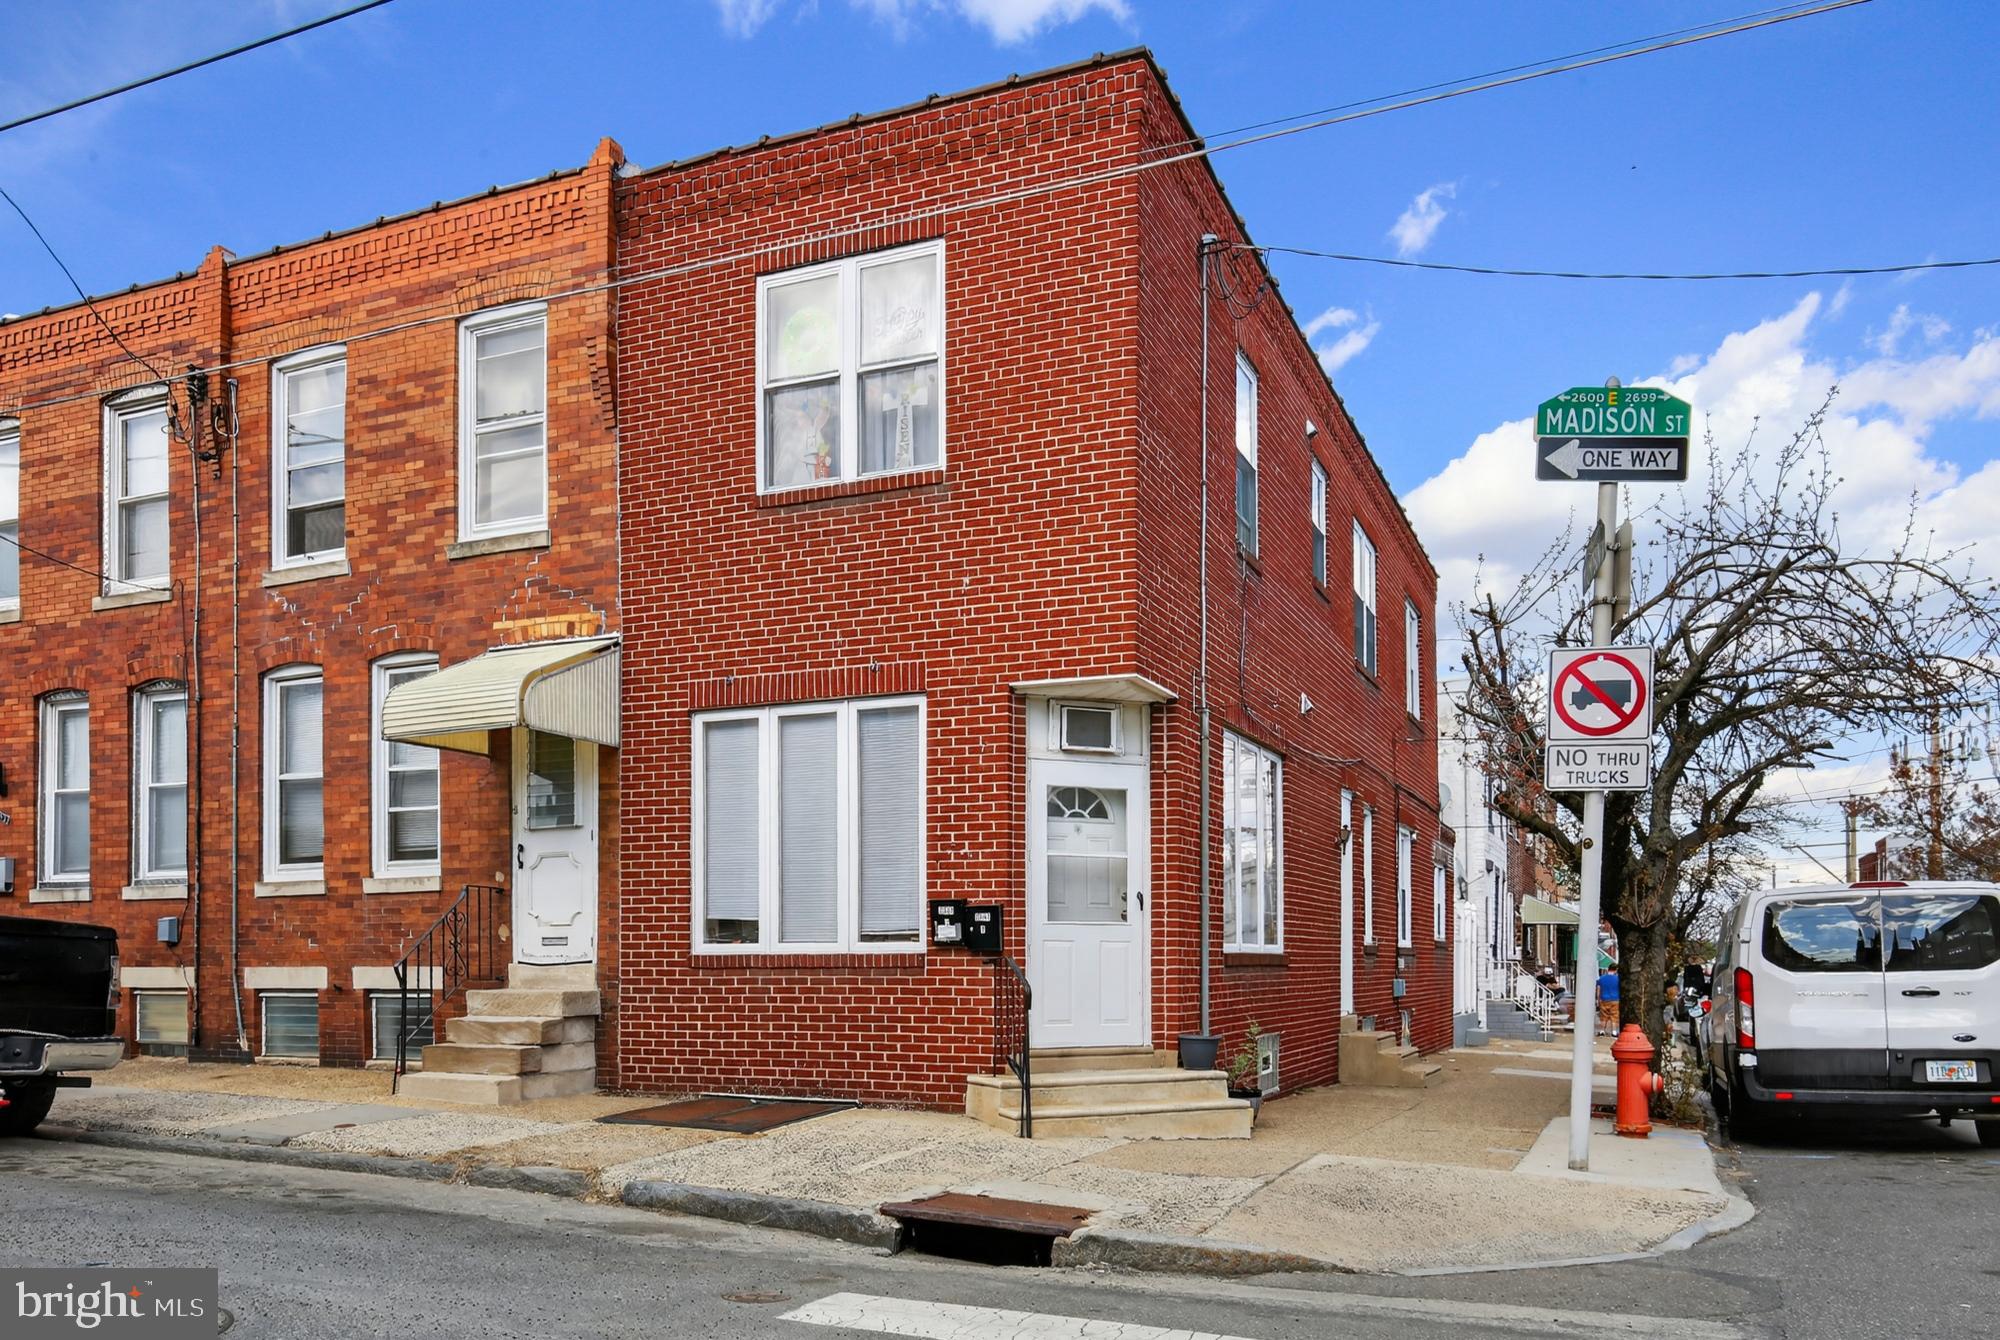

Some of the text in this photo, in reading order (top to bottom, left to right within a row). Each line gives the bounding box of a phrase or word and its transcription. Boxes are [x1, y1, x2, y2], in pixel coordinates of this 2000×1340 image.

[1571, 391, 1657, 406] 2600 E 2699
[1546, 407, 1684, 433] MADISON ST
[1582, 450, 1673, 468] ONE WAY
[1556, 749, 1640, 767] NO THRU
[1566, 770, 1629, 784] TRUCKS
